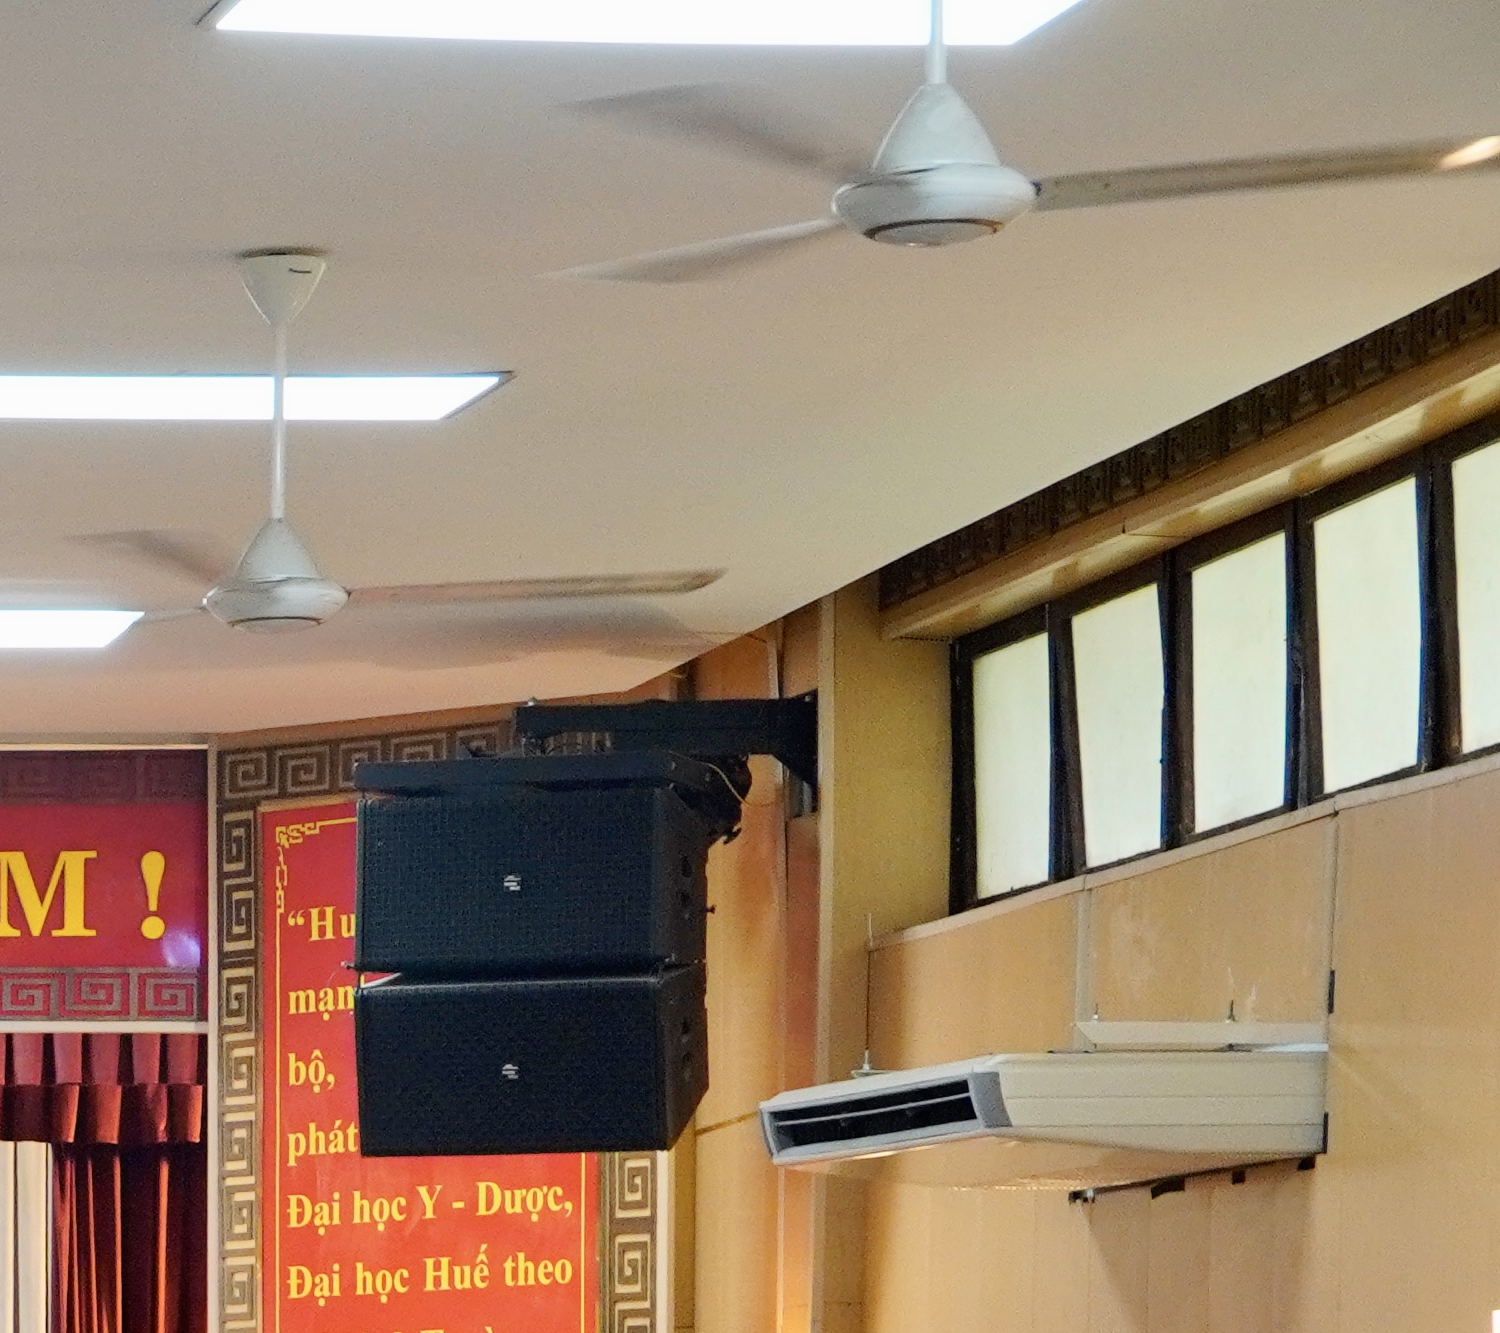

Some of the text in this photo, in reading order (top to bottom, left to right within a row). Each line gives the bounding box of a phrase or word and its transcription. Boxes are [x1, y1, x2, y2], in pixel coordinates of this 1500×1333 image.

[138, 848, 167, 940] !
[288, 907, 355, 940] “Hu
[289, 986, 354, 1020] mạn
[288, 1049, 335, 1093] bộ,
[288, 1120, 358, 1166] phát
[287, 1192, 341, 1235] Đại
[353, 1191, 406, 1232] học
[416, 1185, 443, 1219] Y
[476, 1182, 573, 1222] Dược,
[287, 1244, 572, 1306] Đại học Huế theo
